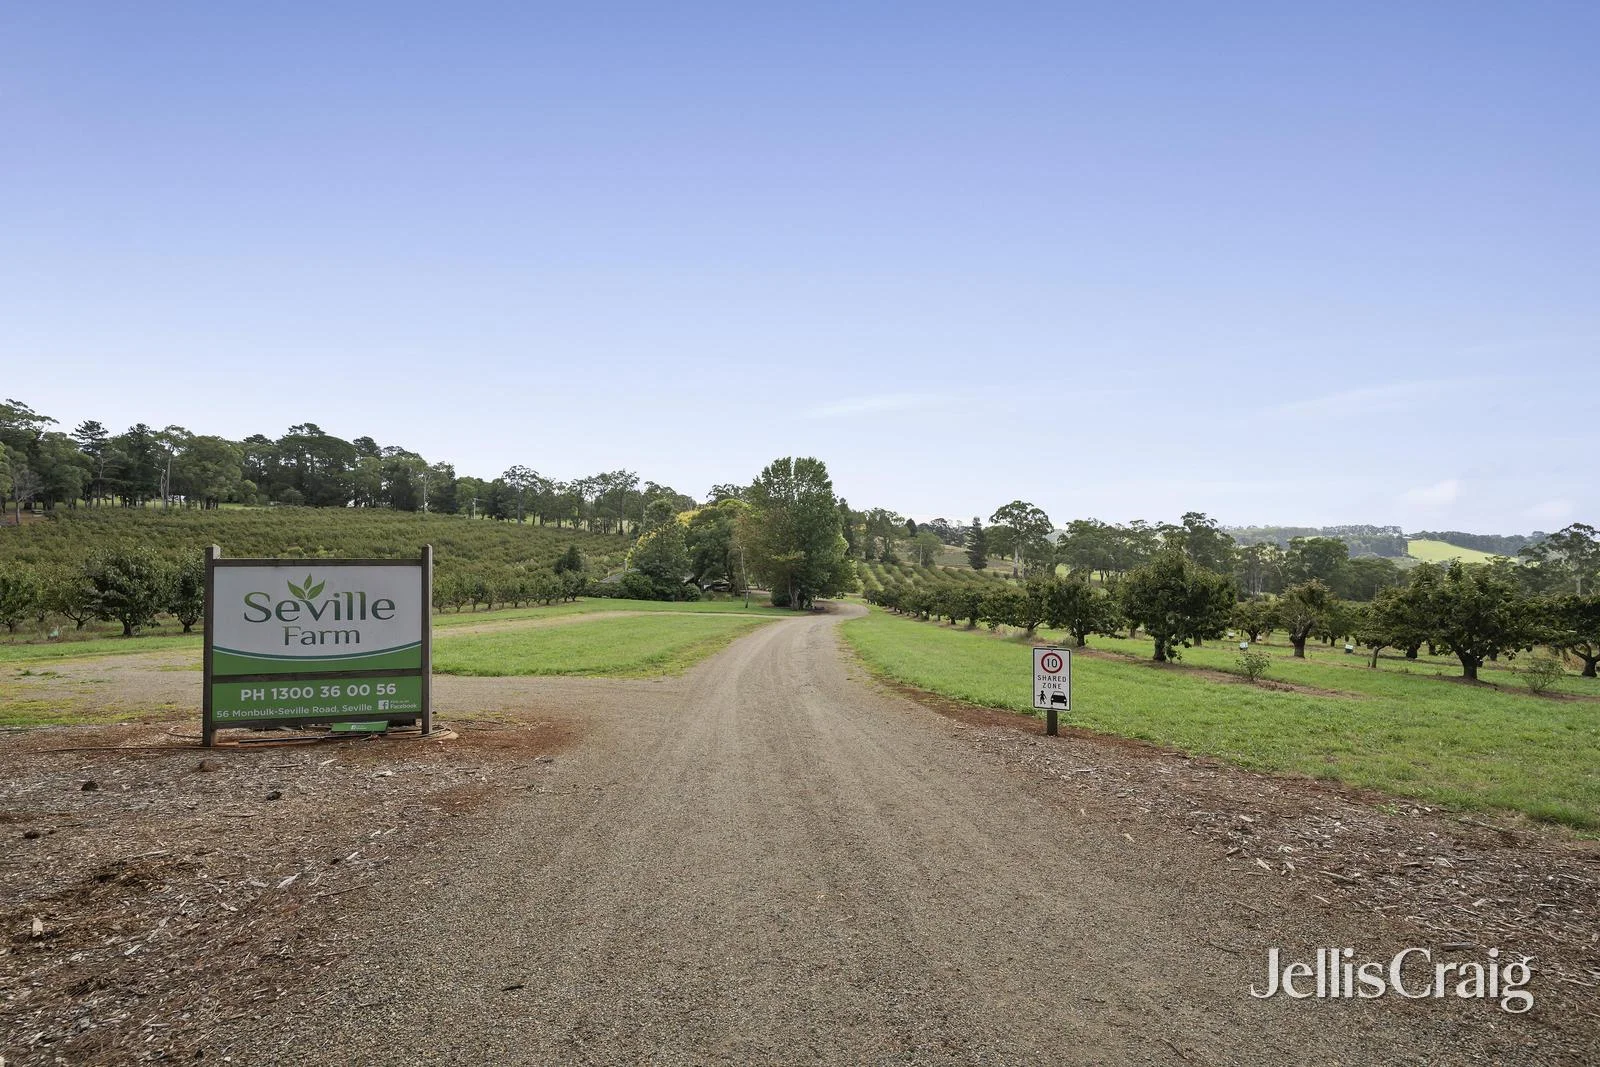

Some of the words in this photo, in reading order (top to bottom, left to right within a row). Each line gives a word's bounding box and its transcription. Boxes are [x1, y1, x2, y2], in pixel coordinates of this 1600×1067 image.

[243, 591, 396, 623] Seville
[283, 626, 361, 646] Farm
[1047, 658, 1058, 668] 10
[241, 688, 265, 701] PH
[271, 687, 314, 700] 1300
[320, 685, 341, 698] 36
[347, 684, 371, 696] 00
[376, 683, 397, 695] 56
[216, 710, 229, 718] 56
[232, 706, 310, 718] Monbulk-Seville
[342, 703, 373, 712] Seville
